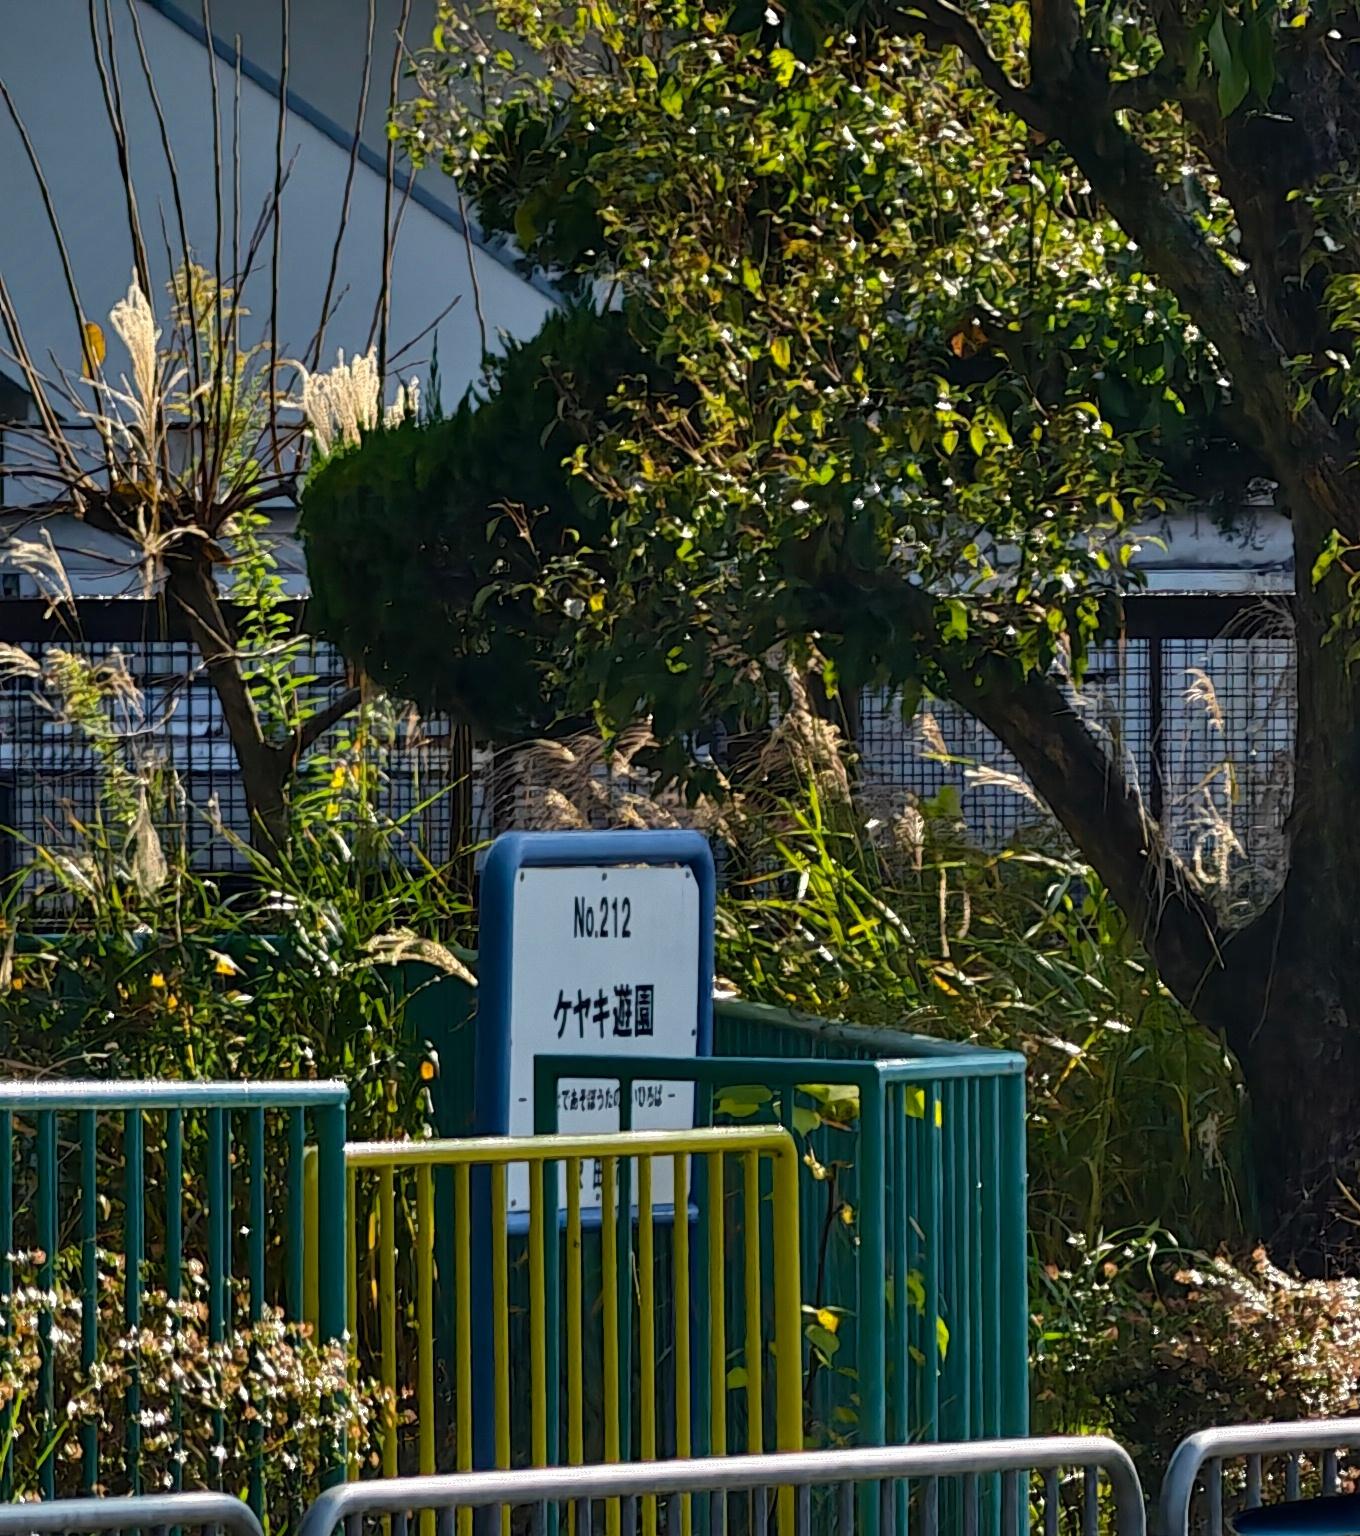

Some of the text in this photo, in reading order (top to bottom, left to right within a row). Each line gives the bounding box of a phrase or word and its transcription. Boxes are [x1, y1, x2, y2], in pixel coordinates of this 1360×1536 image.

[573, 896, 631, 938] No.212
[553, 984, 654, 1039] ケヤキ遊園
